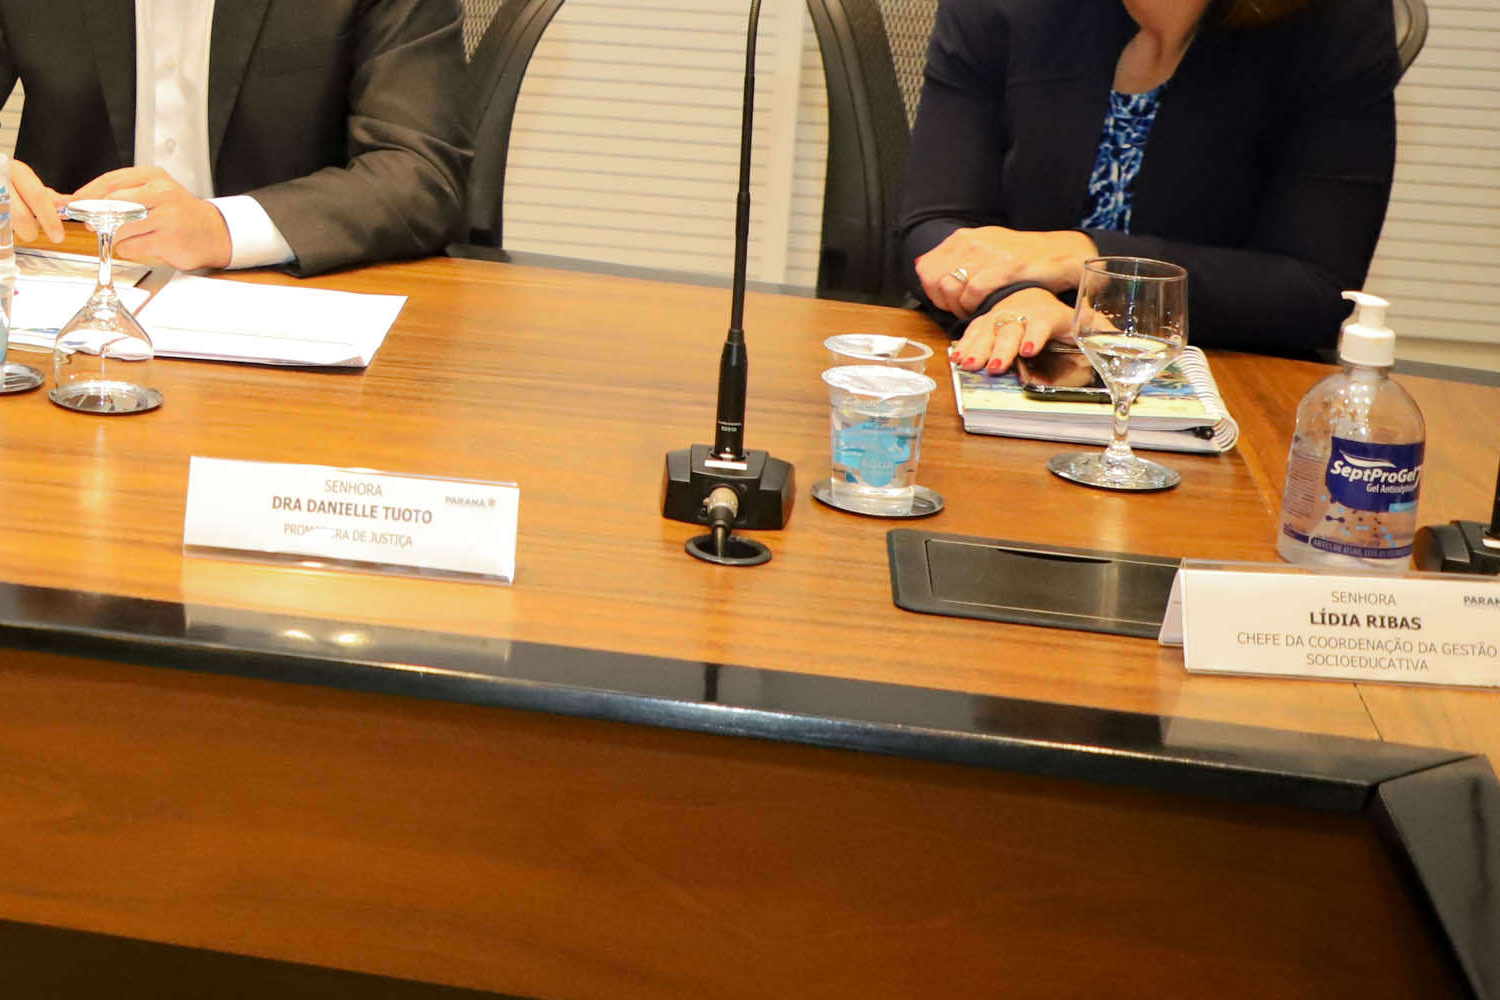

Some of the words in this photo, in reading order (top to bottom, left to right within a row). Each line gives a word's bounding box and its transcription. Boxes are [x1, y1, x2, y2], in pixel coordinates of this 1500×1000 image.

[1330, 460, 1416, 483] SeptProGel
[324, 479, 383, 496] SENHORA
[1366, 484, 1379, 493] Gel
[272, 495, 302, 512] DRA
[306, 499, 378, 519] DANIELLE
[383, 506, 433, 525] TUOTO
[352, 529, 368, 543] DE
[369, 531, 413, 549] JUSTIÇA
[1331, 591, 1396, 606] SENHORA
[1309, 608, 1361, 628] LÍDIA
[1366, 615, 1423, 631] RIBAS
[1237, 632, 1281, 647] CHEFE
[1285, 634, 1305, 648] DA
[1308, 635, 1414, 655] COORDENAÇÃO
[1418, 641, 1438, 655] DA
[1441, 642, 1498, 658] GESTÃO
[1306, 653, 1429, 672] SOCIOEDUCATIVA
